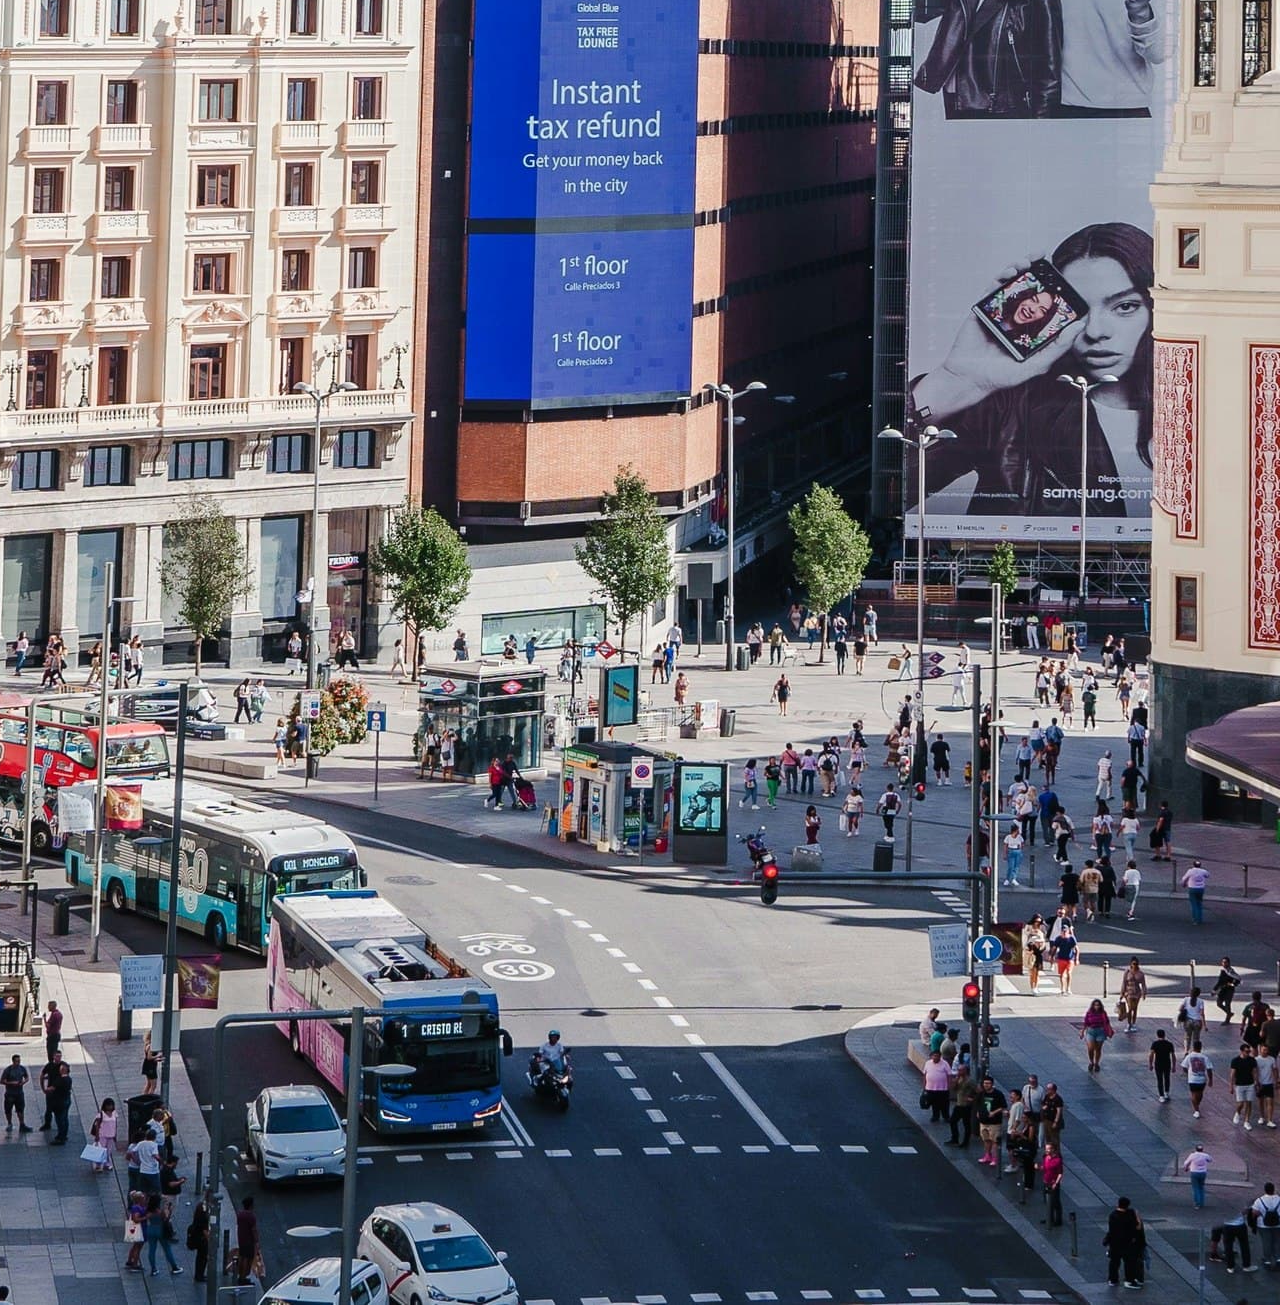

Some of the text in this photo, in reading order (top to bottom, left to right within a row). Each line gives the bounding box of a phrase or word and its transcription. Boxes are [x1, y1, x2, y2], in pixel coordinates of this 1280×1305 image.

[577, 3, 619, 13] Global Blue
[577, 27, 619, 37] TAX FREE
[578, 38, 618, 48] LOUNGE
[552, 79, 642, 105] Instant
[526, 110, 661, 139] tax refund
[523, 151, 664, 171] Get your money back
[564, 178, 628, 194] in the city
[560, 255, 629, 277] 1st floor
[564, 281, 621, 291] Calle Preciados 3
[552, 331, 621, 352] 1st floor
[557, 357, 613, 367] Calle Preciados 3
[329, 556, 359, 565] PRIMOR
[180, 837, 196, 853] DRID
[284, 856, 339, 871] 001 MONCLOA
[498, 964, 538, 976] 30
[421, 1023, 451, 1036] CRISTO
